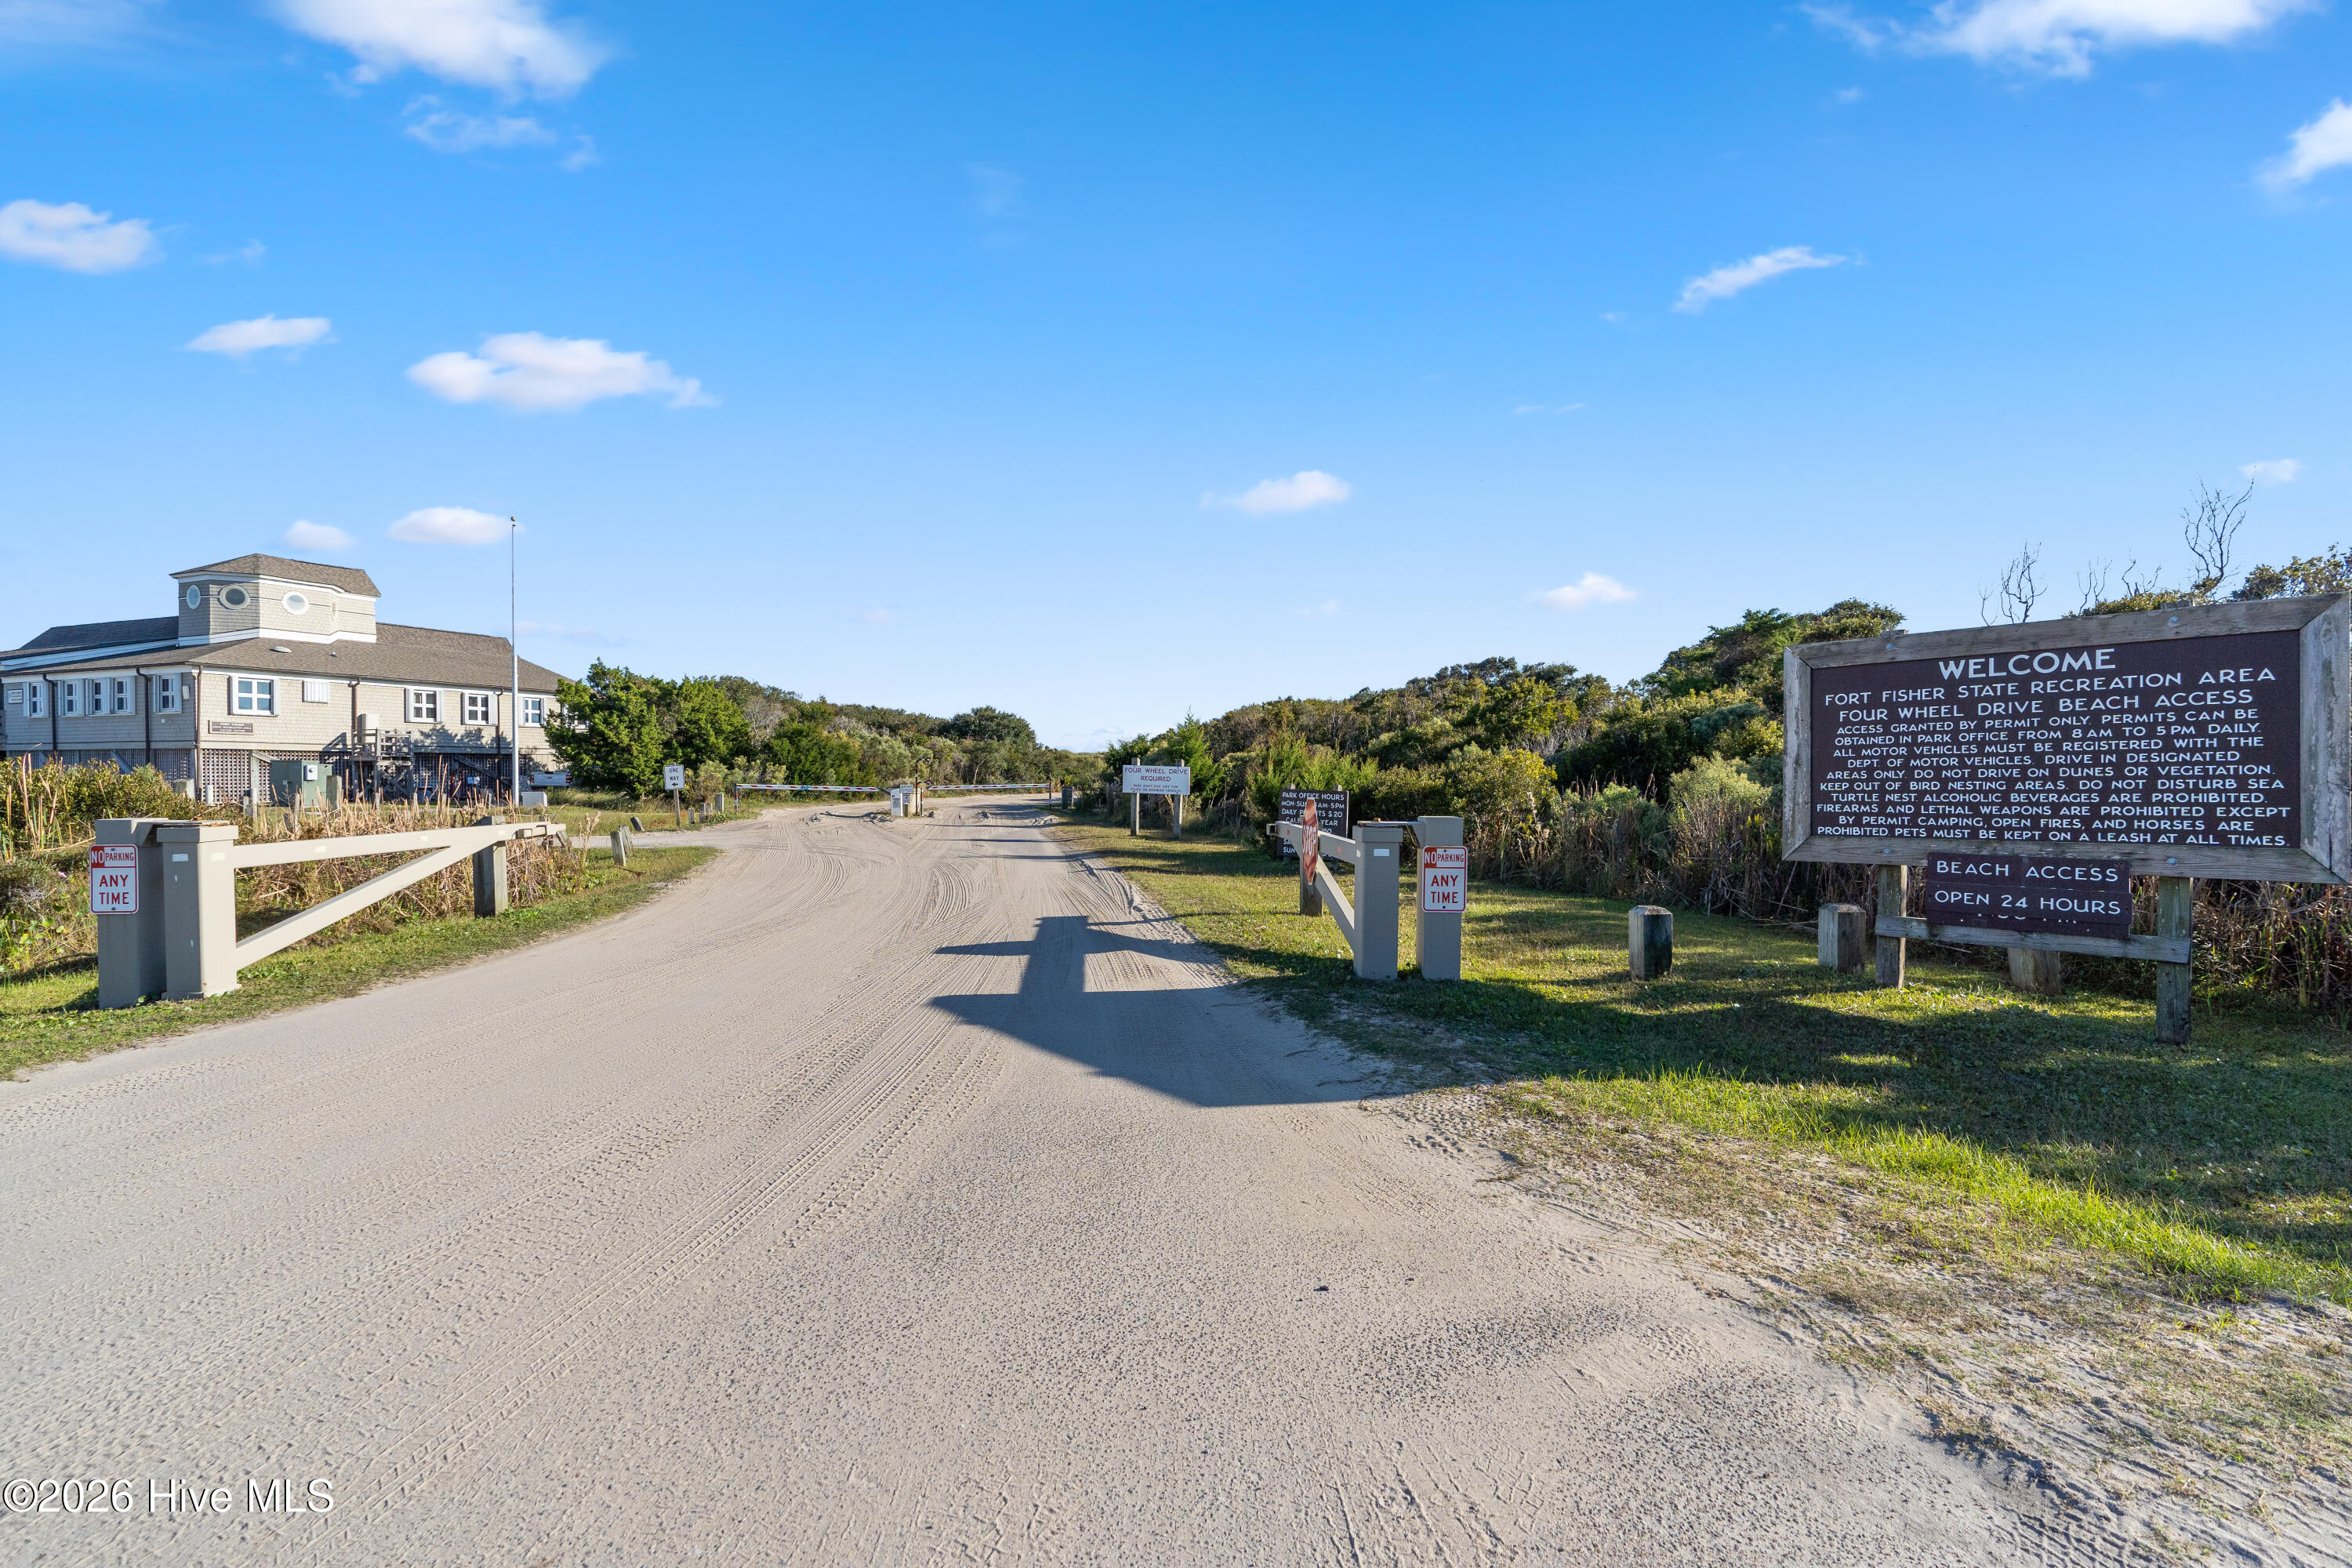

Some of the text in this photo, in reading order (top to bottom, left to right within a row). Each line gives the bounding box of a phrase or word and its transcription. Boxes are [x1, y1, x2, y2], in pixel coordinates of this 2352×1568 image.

[1938, 648, 2117, 681] WELCOME
[1825, 667, 2276, 706] FORT FISHER STATE RECREATION AREA
[1839, 688, 2253, 722] FOUR WHEEL DRIVE BEACH ACCESS
[1836, 709, 2259, 735] ACCESS GRANTED BY PERMIT ONLY. PERMITS CAN BE
[1835, 735, 1895, 746] OBTAINED
[1900, 735, 1911, 744] IN
[1918, 733, 1951, 743] PARK
[1958, 731, 2009, 742] OFFICE
[2018, 730, 2062, 740] FROM
[2122, 726, 2146, 736] TO
[2208, 722, 2261, 734] DAILY.
[1833, 736, 2264, 757] ALL MOTOR VEHICLES MUST BE REGISTERED WITH THE
[1886, 758, 1904, 768] OF
[1909, 757, 1959, 767] MOTOR
[2045, 754, 2092, 764] DRIVE
[2100, 753, 2116, 764] IN
[2126, 750, 2240, 763] DESIGNATED
[1826, 764, 2275, 779] AREAS ONLY. DO NOT DRIVE ON DUNES OR VEGETATION.
[1820, 779, 2285, 791] KEEP OUT OF BIRD NESTING AREAS. DO NOT DISTURB SEA
[1831, 793, 1880, 802] TURTLE
[1923, 793, 2002, 802] ALCOHOLIC
[2010, 793, 2100, 803] BEVERAGES
[2108, 793, 2142, 803] ARE
[2151, 793, 2267, 803] PROHIBITED.
[1817, 804, 2291, 817] FIREARMS AND LETHAL WEAPONS ARE PROHIBITED EXCEPT
[1838, 815, 1856, 824] BY
[1918, 816, 1987, 828] CAMPING,
[1991, 818, 2031, 827] OPEN
[2040, 818, 2085, 829] FIRES,
[2092, 819, 2127, 829] AND
[2134, 819, 2205, 830] HORSES
[2217, 820, 2255, 831] ARE
[1302, 825, 1317, 857] STOP
[1817, 826, 2289, 846] PROHIBITED. PETS MUST BE KEPT ON A LEASH AT ALL TIMES.
[91, 851, 134, 864] NO PARKING
[1425, 851, 1465, 864] NO PARKING
[1936, 860, 2118, 882] BEACH ACCESS
[100, 874, 129, 887] ANY
[1431, 874, 1458, 887] ANY
[99, 892, 129, 905] TIME
[1430, 891, 1458, 904] TIME
[1934, 890, 2121, 915] OPEN 24 HOURS
